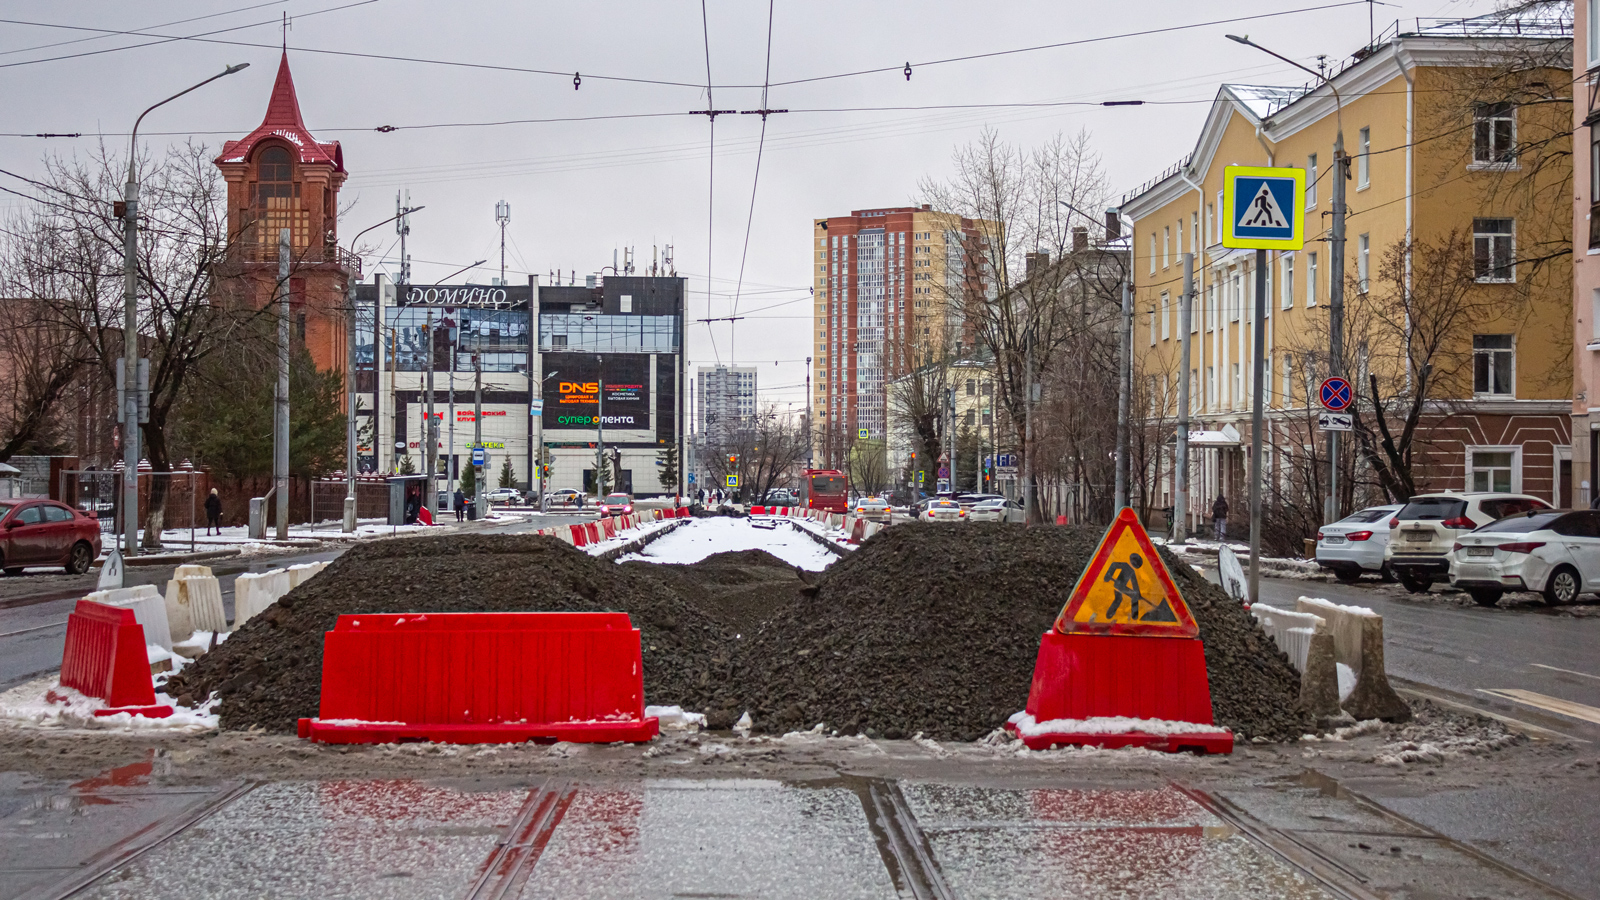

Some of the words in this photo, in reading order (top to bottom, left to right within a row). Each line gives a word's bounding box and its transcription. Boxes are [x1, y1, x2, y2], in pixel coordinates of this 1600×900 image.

[406, 287, 507, 304] ДОМИНО
[559, 382, 599, 393] DNS
[558, 416, 591, 425] супер
